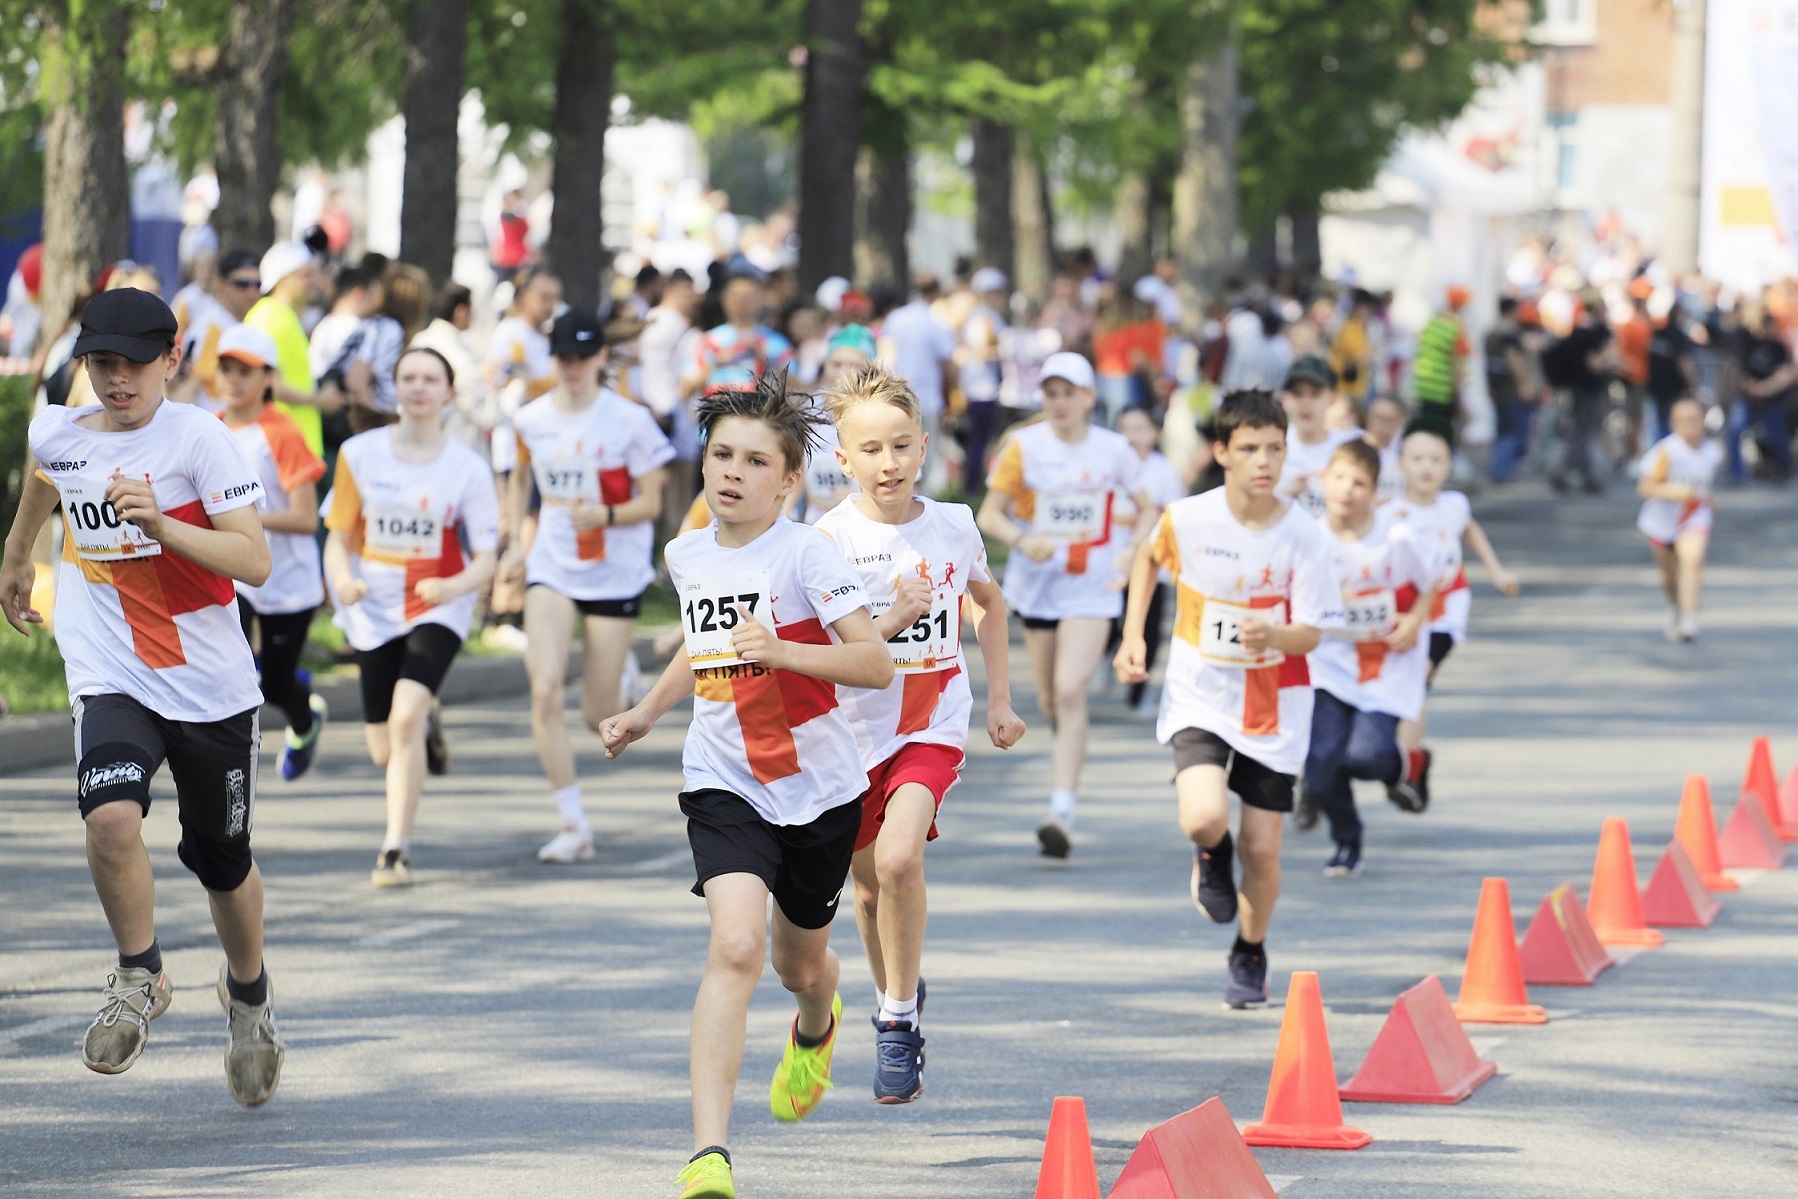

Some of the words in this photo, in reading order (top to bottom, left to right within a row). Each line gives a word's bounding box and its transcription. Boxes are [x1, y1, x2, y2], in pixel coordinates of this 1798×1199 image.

[224, 482, 260, 500] ЕВРА
[69, 501, 137, 530] 100
[376, 517, 434, 537] 1042
[856, 553, 892, 565] ЕВРАЗ
[686, 593, 760, 634] 1257
[872, 609, 948, 644] 251
[1213, 621, 1242, 644] 12
[893, 657, 911, 665] ЯТЬ!
